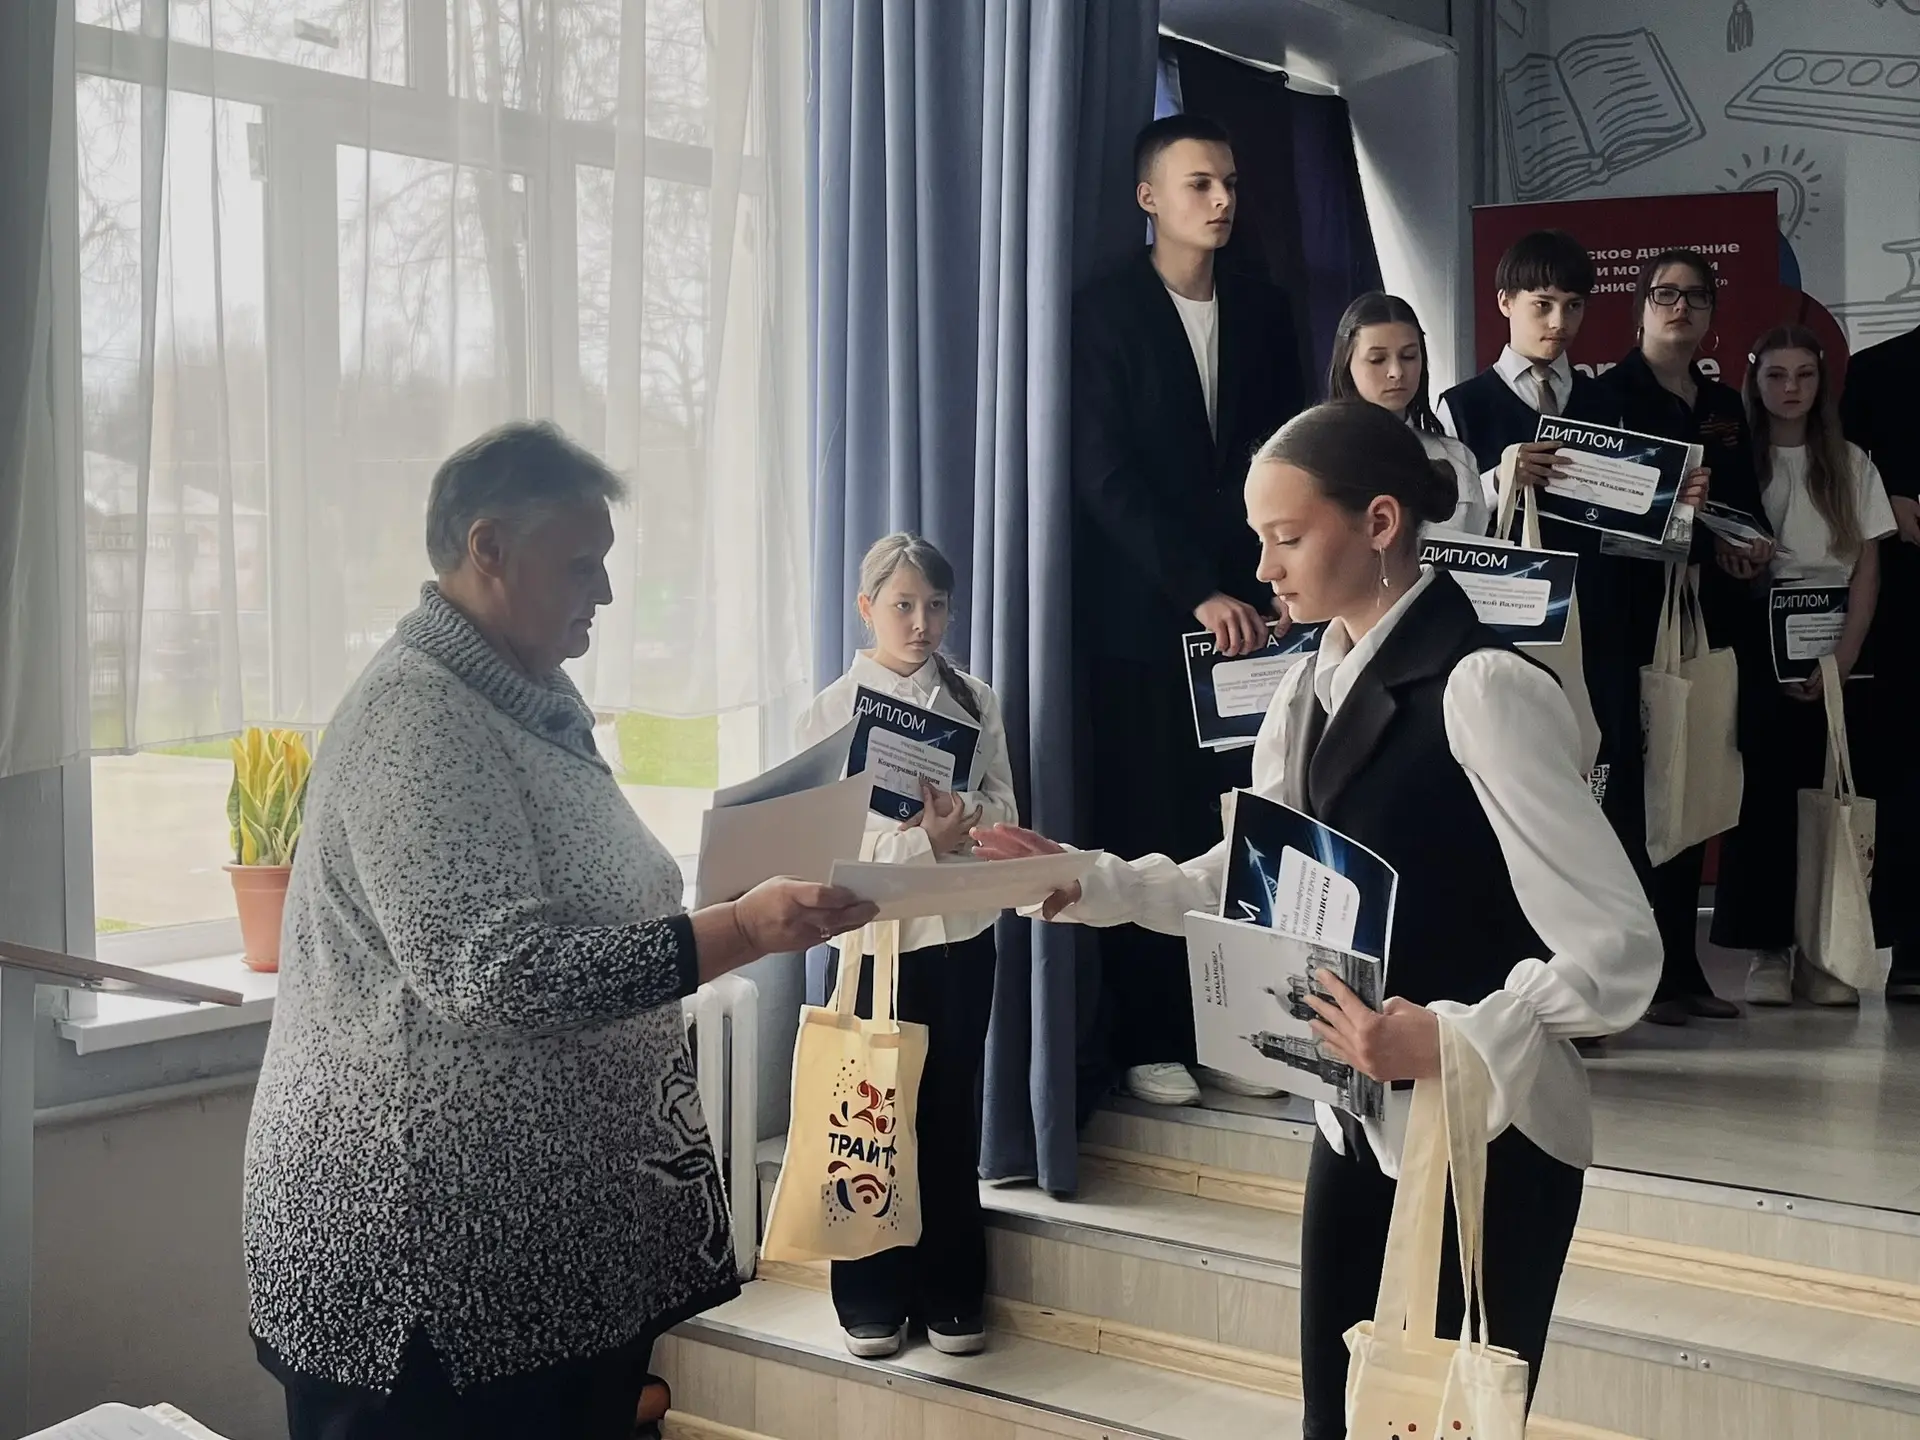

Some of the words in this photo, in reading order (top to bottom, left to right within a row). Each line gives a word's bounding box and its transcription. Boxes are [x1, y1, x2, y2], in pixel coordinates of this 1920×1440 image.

[1587, 247, 1632, 261] ское
[1540, 425, 1624, 452] ДИПЛОМ
[1420, 546, 1508, 569] ДИПЛОМ
[1773, 594, 1829, 609] ДИПЛОМ
[856, 696, 927, 734] ДИПЛОМ
